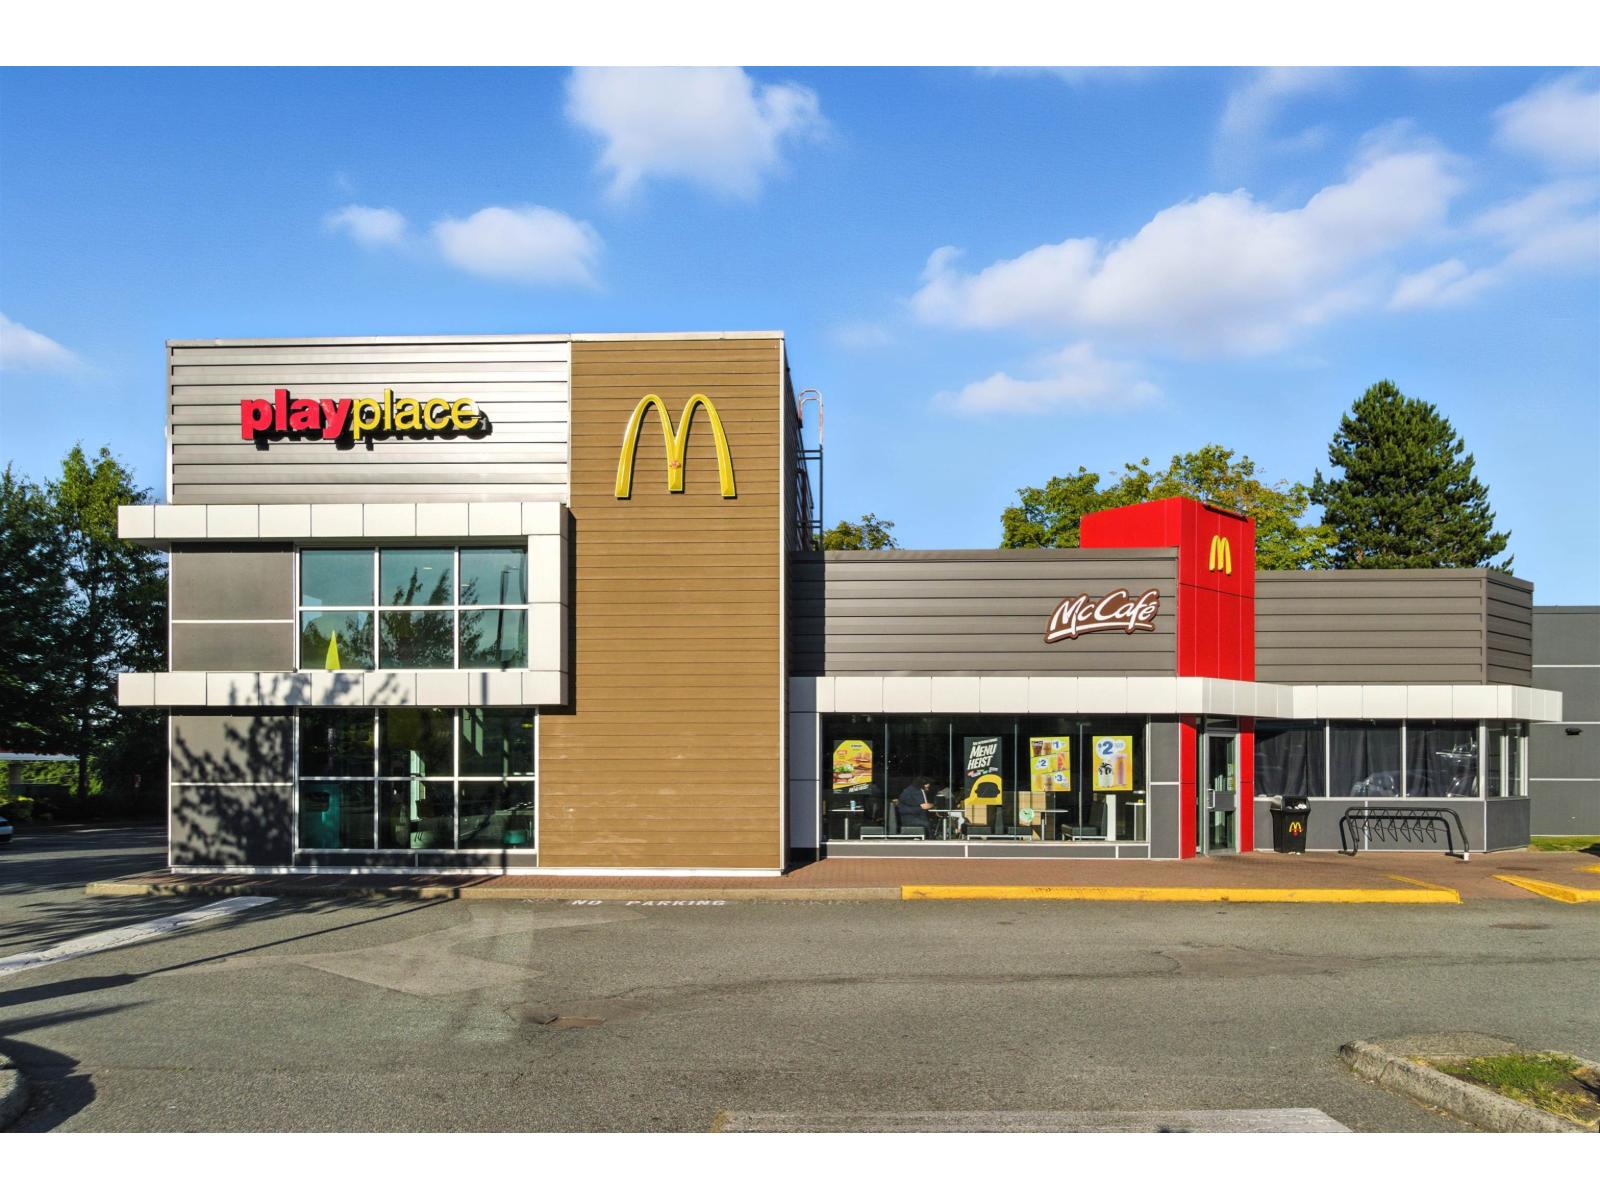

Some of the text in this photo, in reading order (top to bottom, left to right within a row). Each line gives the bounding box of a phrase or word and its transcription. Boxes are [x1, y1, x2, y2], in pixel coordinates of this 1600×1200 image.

[1049, 590, 1157, 635] McCafé
[970, 743, 997, 759] MENU
[967, 755, 994, 770] HEIST
